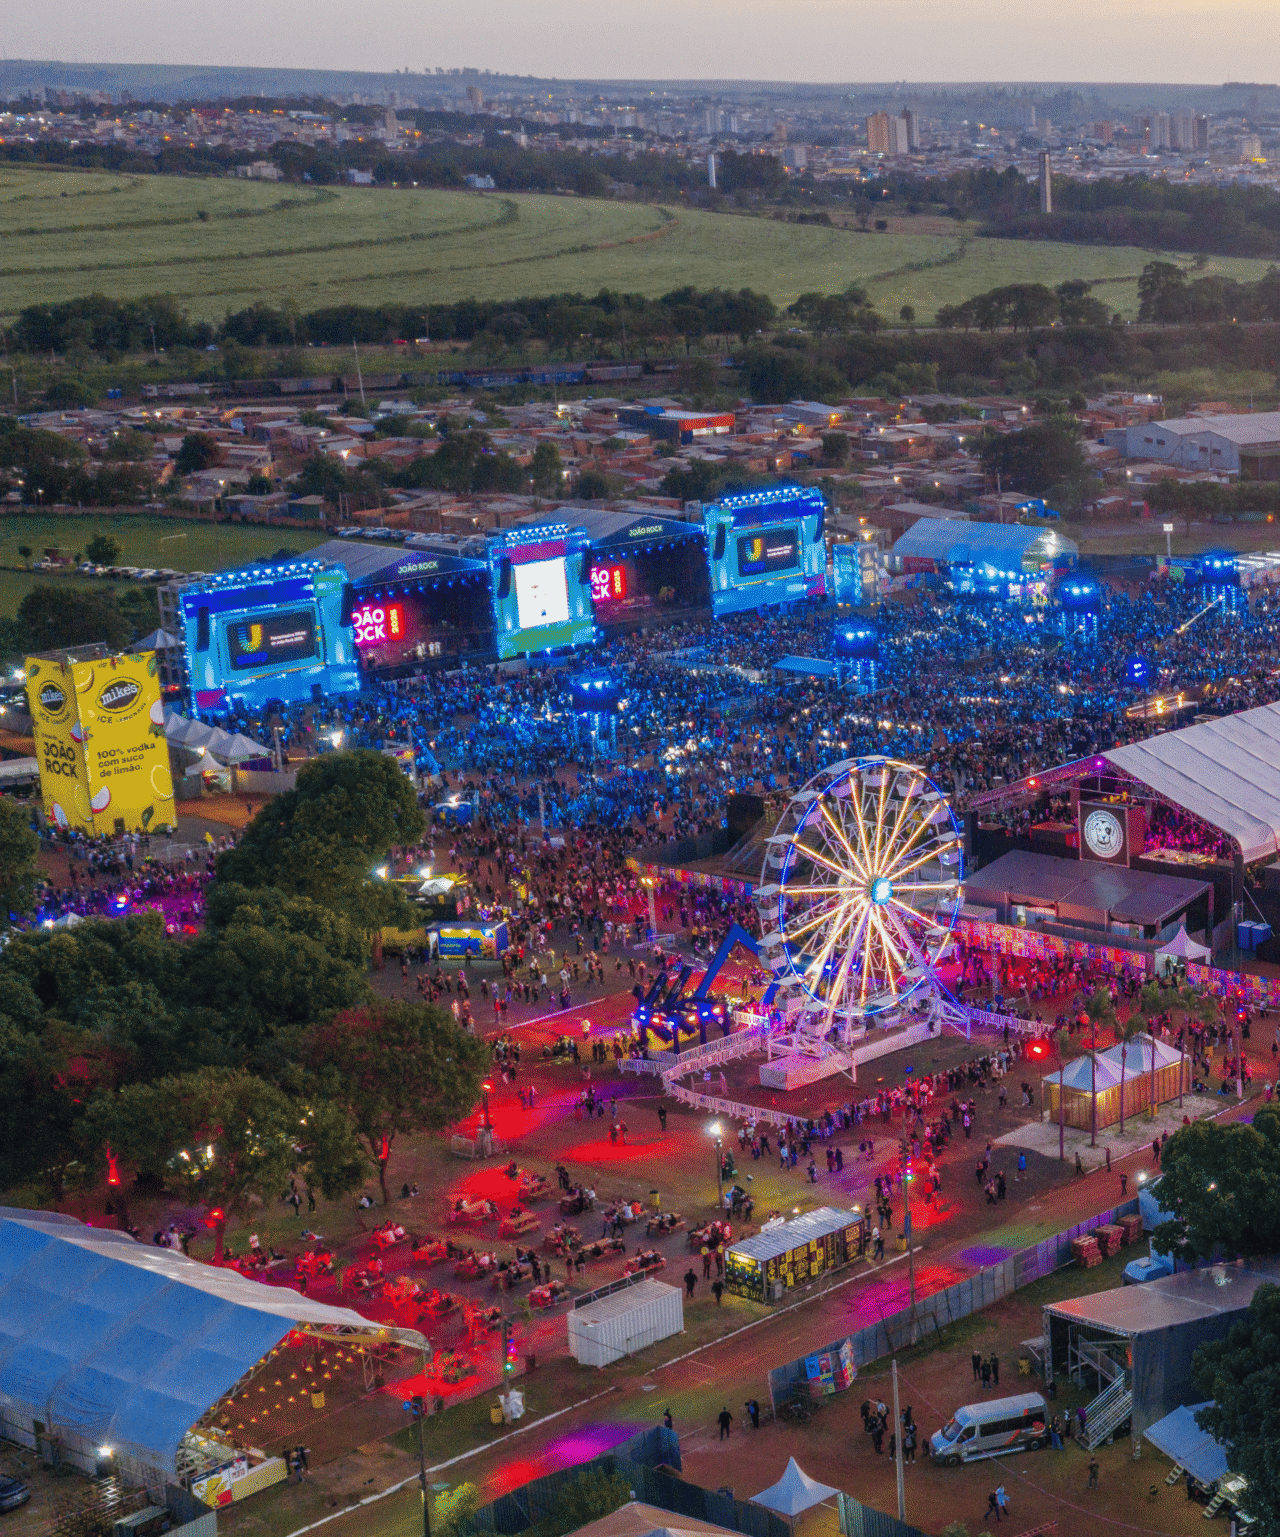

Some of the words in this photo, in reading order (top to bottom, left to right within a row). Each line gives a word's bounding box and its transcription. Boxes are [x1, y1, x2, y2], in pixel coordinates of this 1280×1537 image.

[646, 524, 663, 534] ROCK
[398, 562, 418, 574] JOÃO
[418, 561, 439, 571] ROCK
[101, 684, 138, 706] mike's
[96, 715, 113, 724] ICE
[43, 740, 76, 762] JOÃO
[97, 748, 125, 760] 100%
[126, 743, 156, 754] vodka
[45, 758, 78, 779] ROCK
[98, 759, 120, 769] com
[121, 753, 145, 764] suco
[99, 769, 112, 778] de
